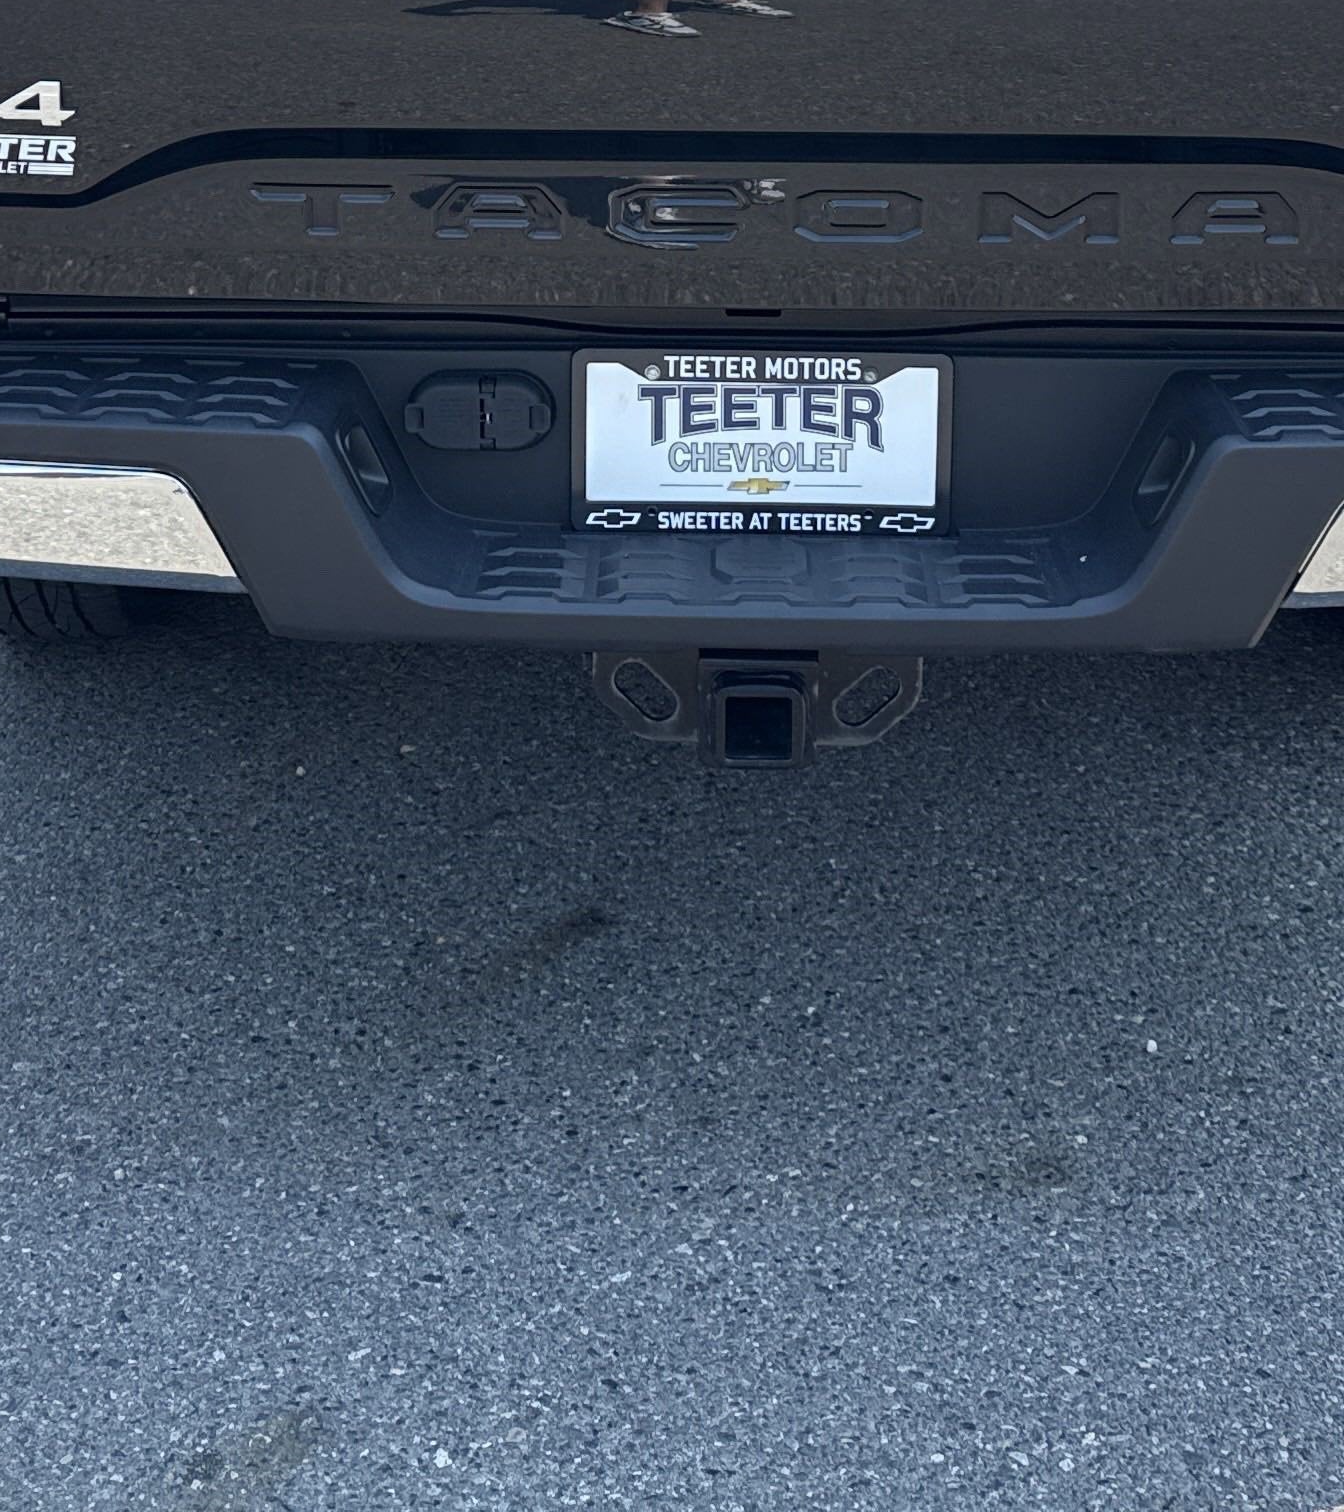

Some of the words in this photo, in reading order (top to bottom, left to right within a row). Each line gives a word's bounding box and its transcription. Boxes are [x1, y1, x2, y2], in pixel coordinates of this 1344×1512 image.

[249, 180, 1302, 247] TACOMA
[664, 355, 756, 379] TEETER
[765, 357, 862, 381] MOTORS
[637, 384, 885, 453] TEETER
[668, 442, 854, 473] CHEVROLET
[657, 512, 744, 531] SWEETER
[749, 513, 772, 531] AT
[777, 513, 862, 532] TEETERS
